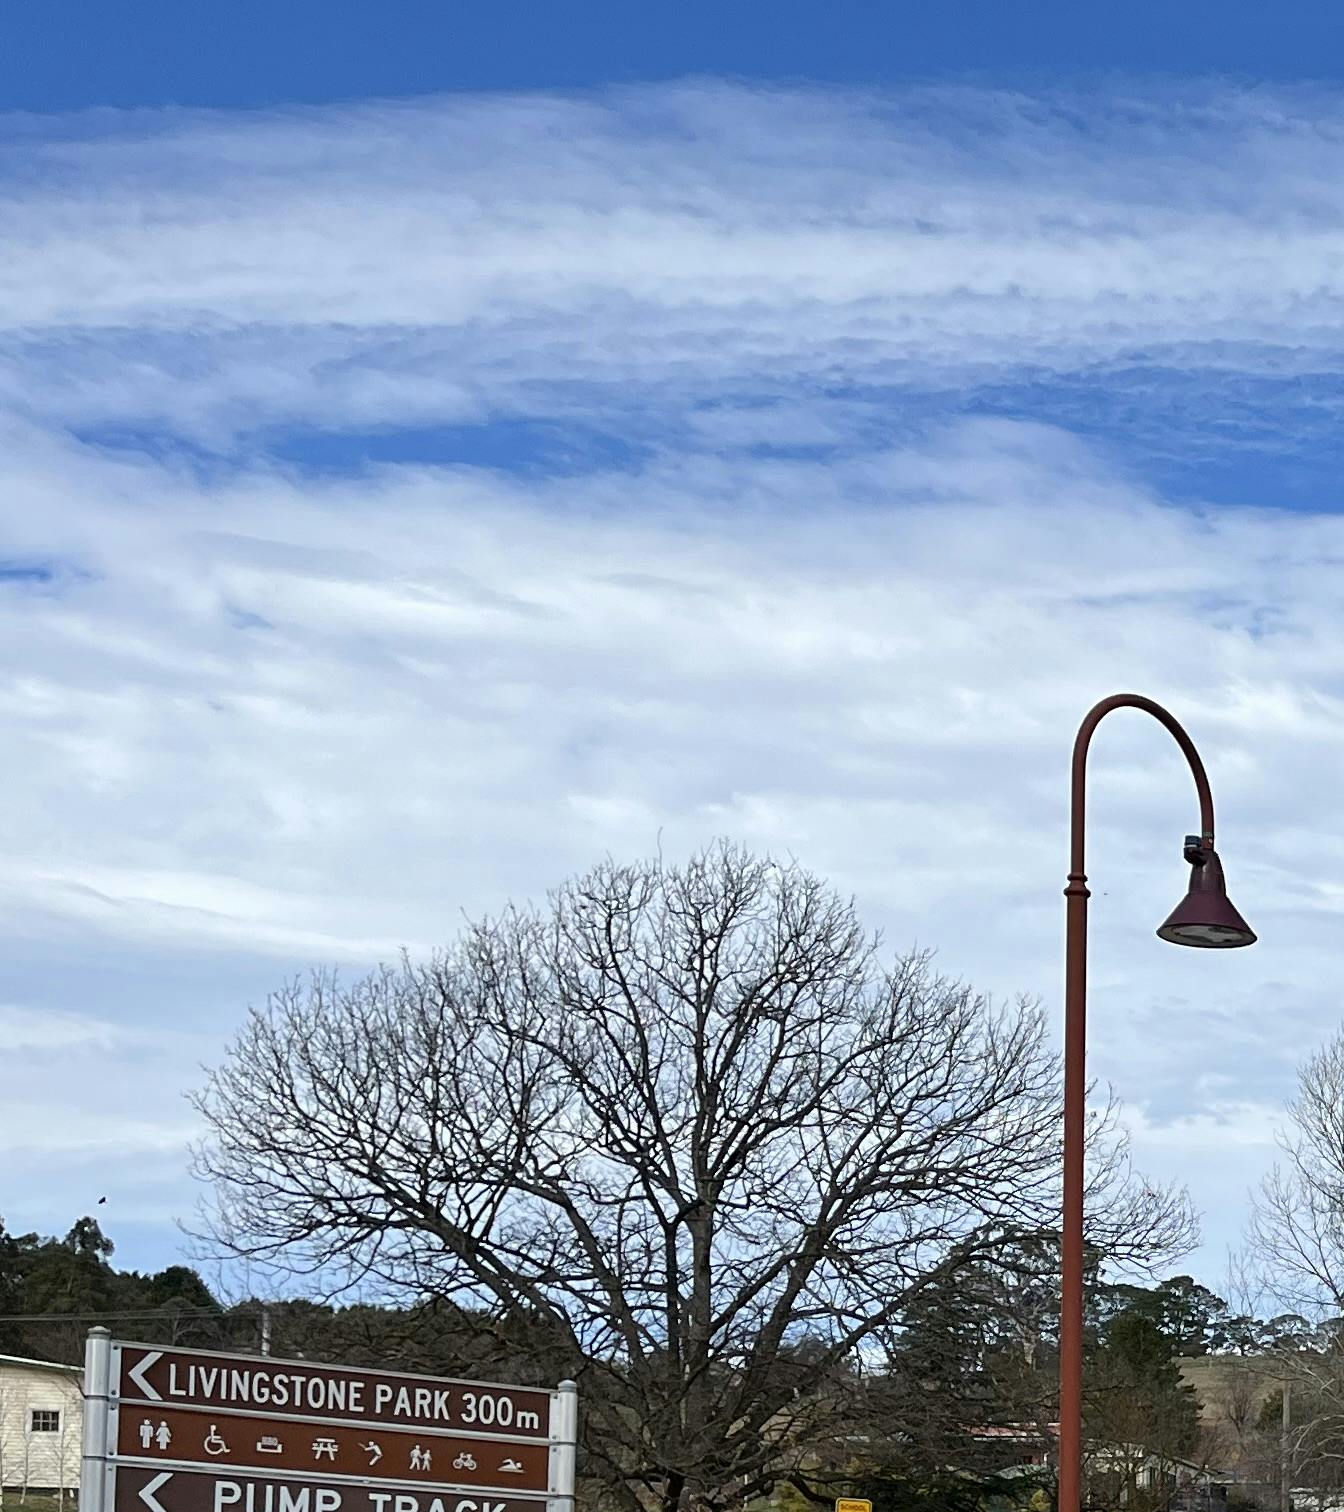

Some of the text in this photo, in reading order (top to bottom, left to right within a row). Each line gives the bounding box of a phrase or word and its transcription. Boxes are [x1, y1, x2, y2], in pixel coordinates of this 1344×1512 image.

[168, 1362, 540, 1430] LIVINGSTONE PARK 300m
